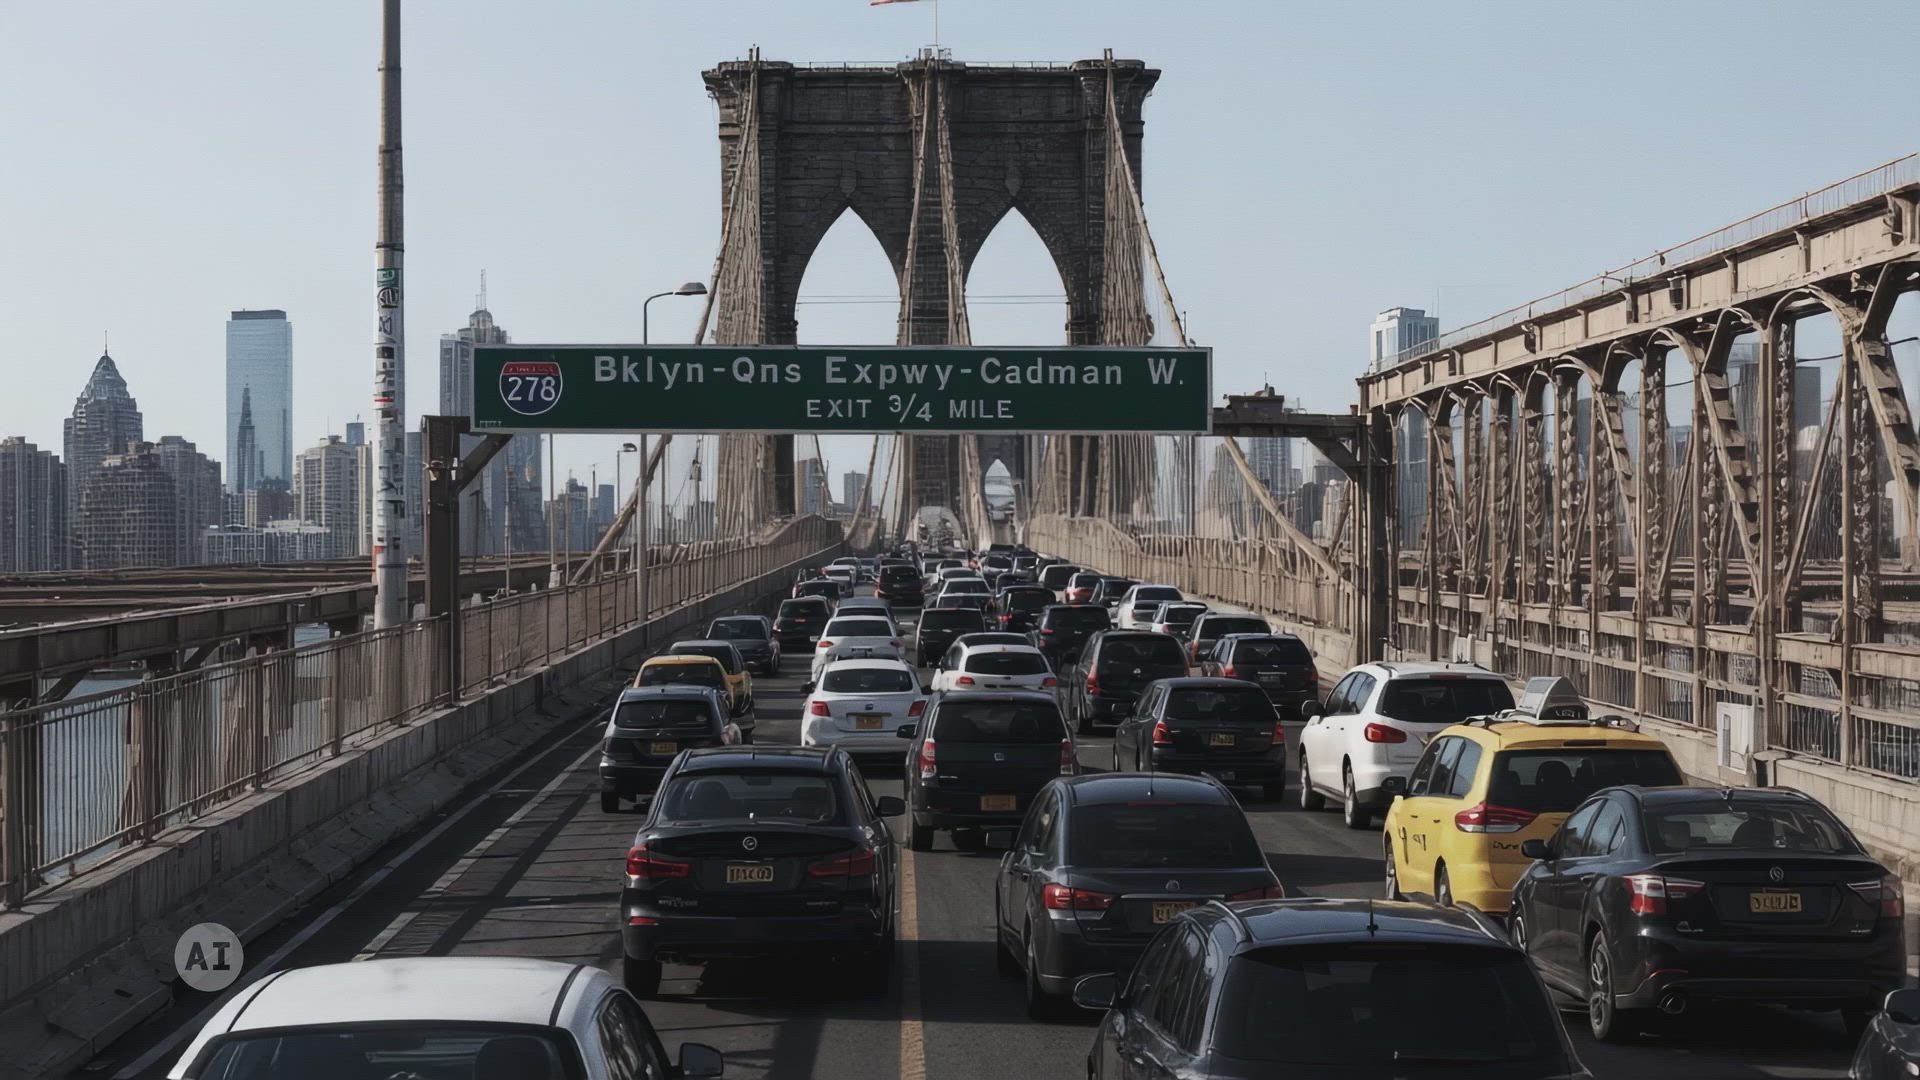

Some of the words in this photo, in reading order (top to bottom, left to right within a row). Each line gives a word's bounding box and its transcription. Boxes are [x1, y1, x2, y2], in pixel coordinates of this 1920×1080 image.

[594, 355, 802, 390] Bklyn-Qns
[825, 356, 1122, 391] Expwy-Cadman
[1147, 357, 1185, 385] W.
[507, 376, 556, 402] 278
[806, 399, 872, 418] EXIT
[949, 399, 1014, 419] MILE
